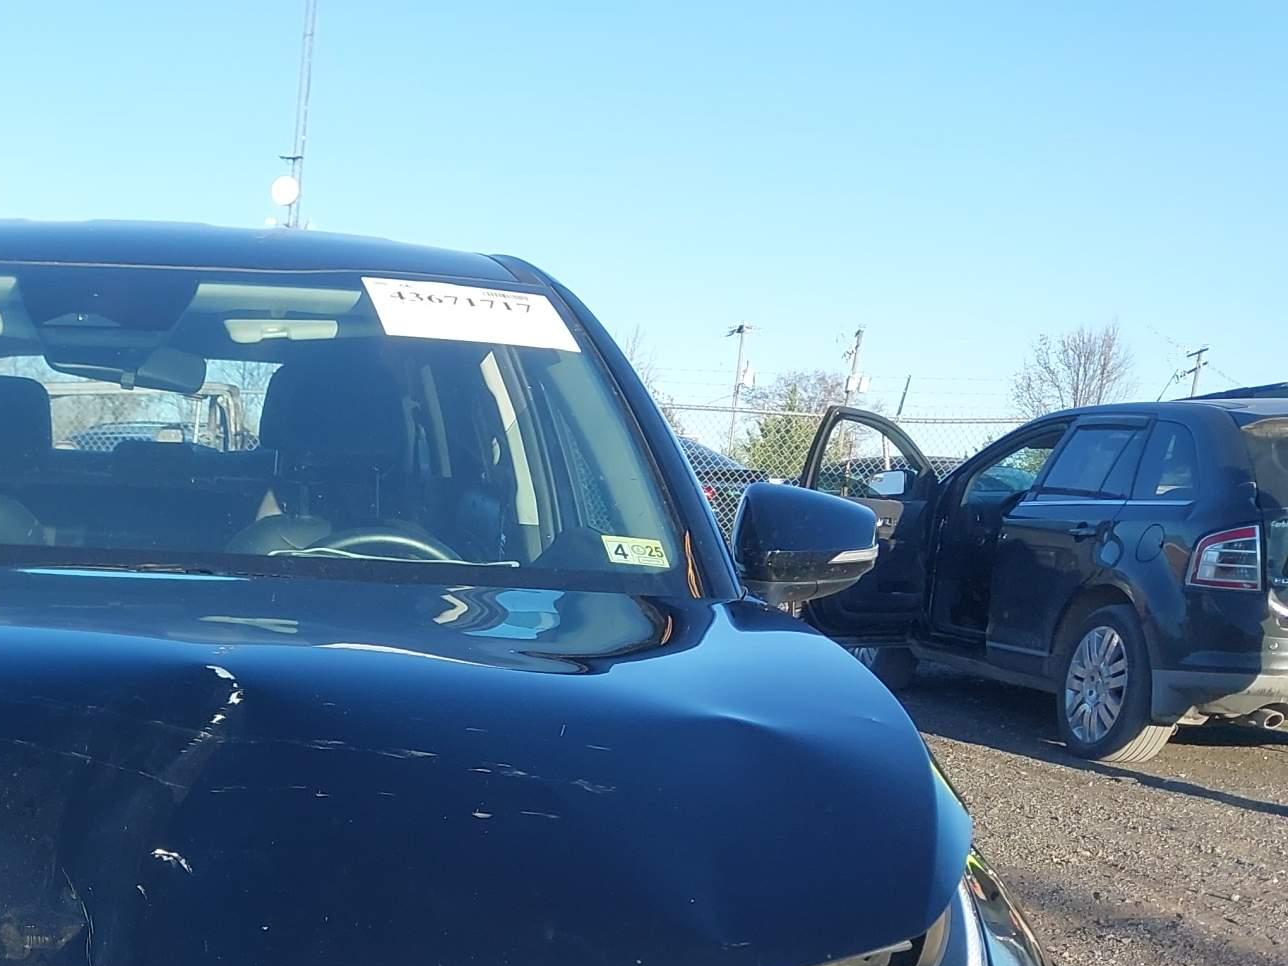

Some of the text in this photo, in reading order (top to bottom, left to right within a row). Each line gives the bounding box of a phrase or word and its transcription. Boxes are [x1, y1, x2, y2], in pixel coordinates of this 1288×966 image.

[390, 290, 531, 313] 43671717
[614, 544, 664, 559] 4 25
